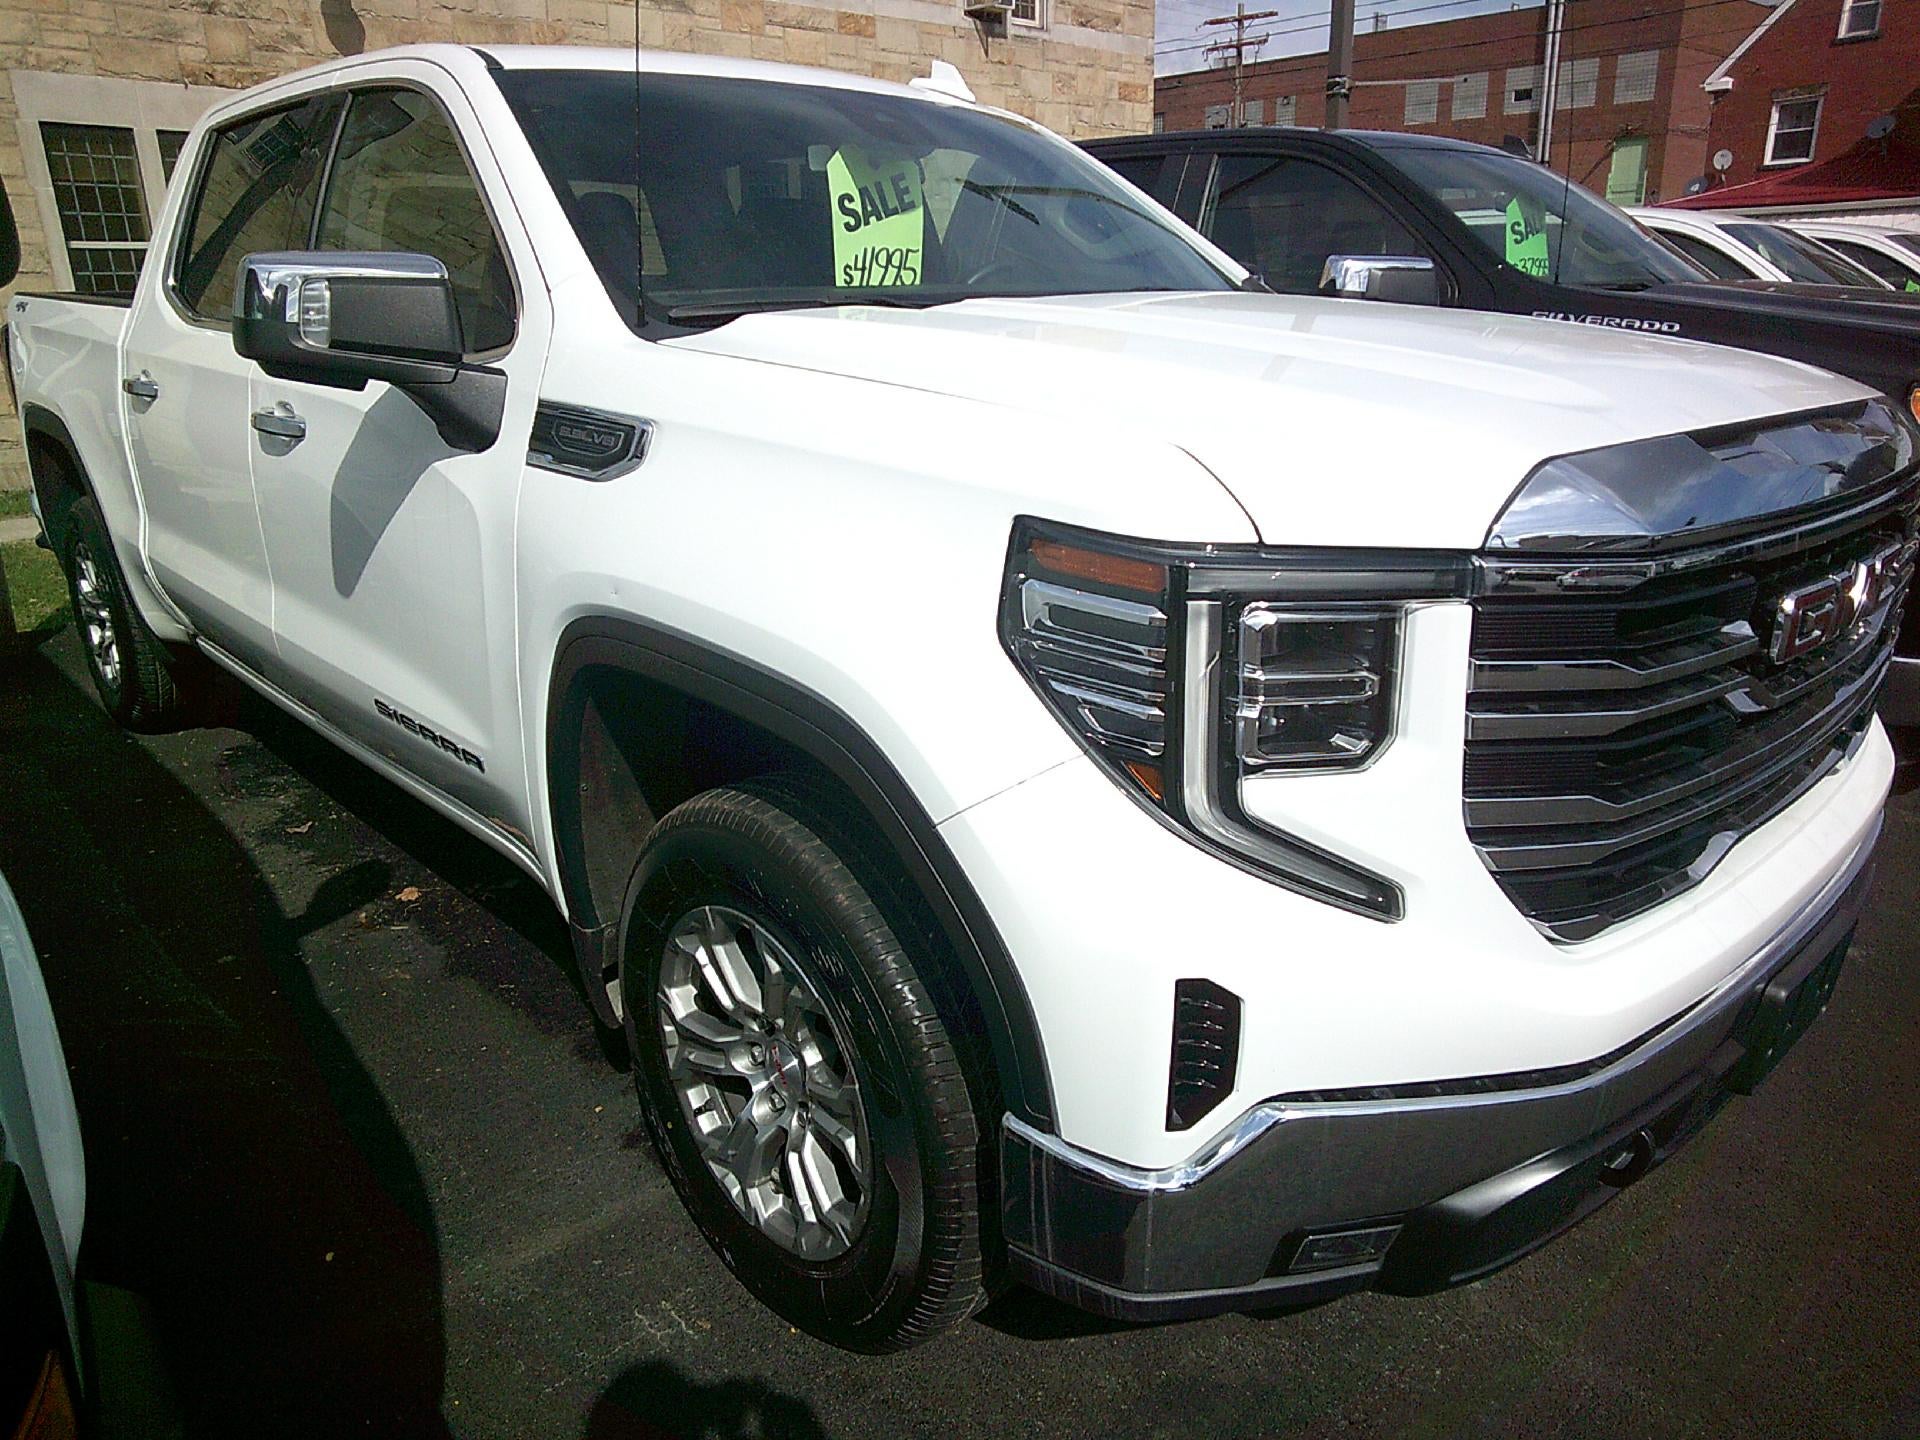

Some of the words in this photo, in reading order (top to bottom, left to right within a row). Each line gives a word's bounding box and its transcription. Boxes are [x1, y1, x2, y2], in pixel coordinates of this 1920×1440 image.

[837, 172, 916, 232] SALE
[843, 246, 919, 286] $41995
[1531, 311, 1680, 333] SILVERADO
[1770, 543, 1903, 665] GMC
[374, 698, 485, 774] SIERRA
